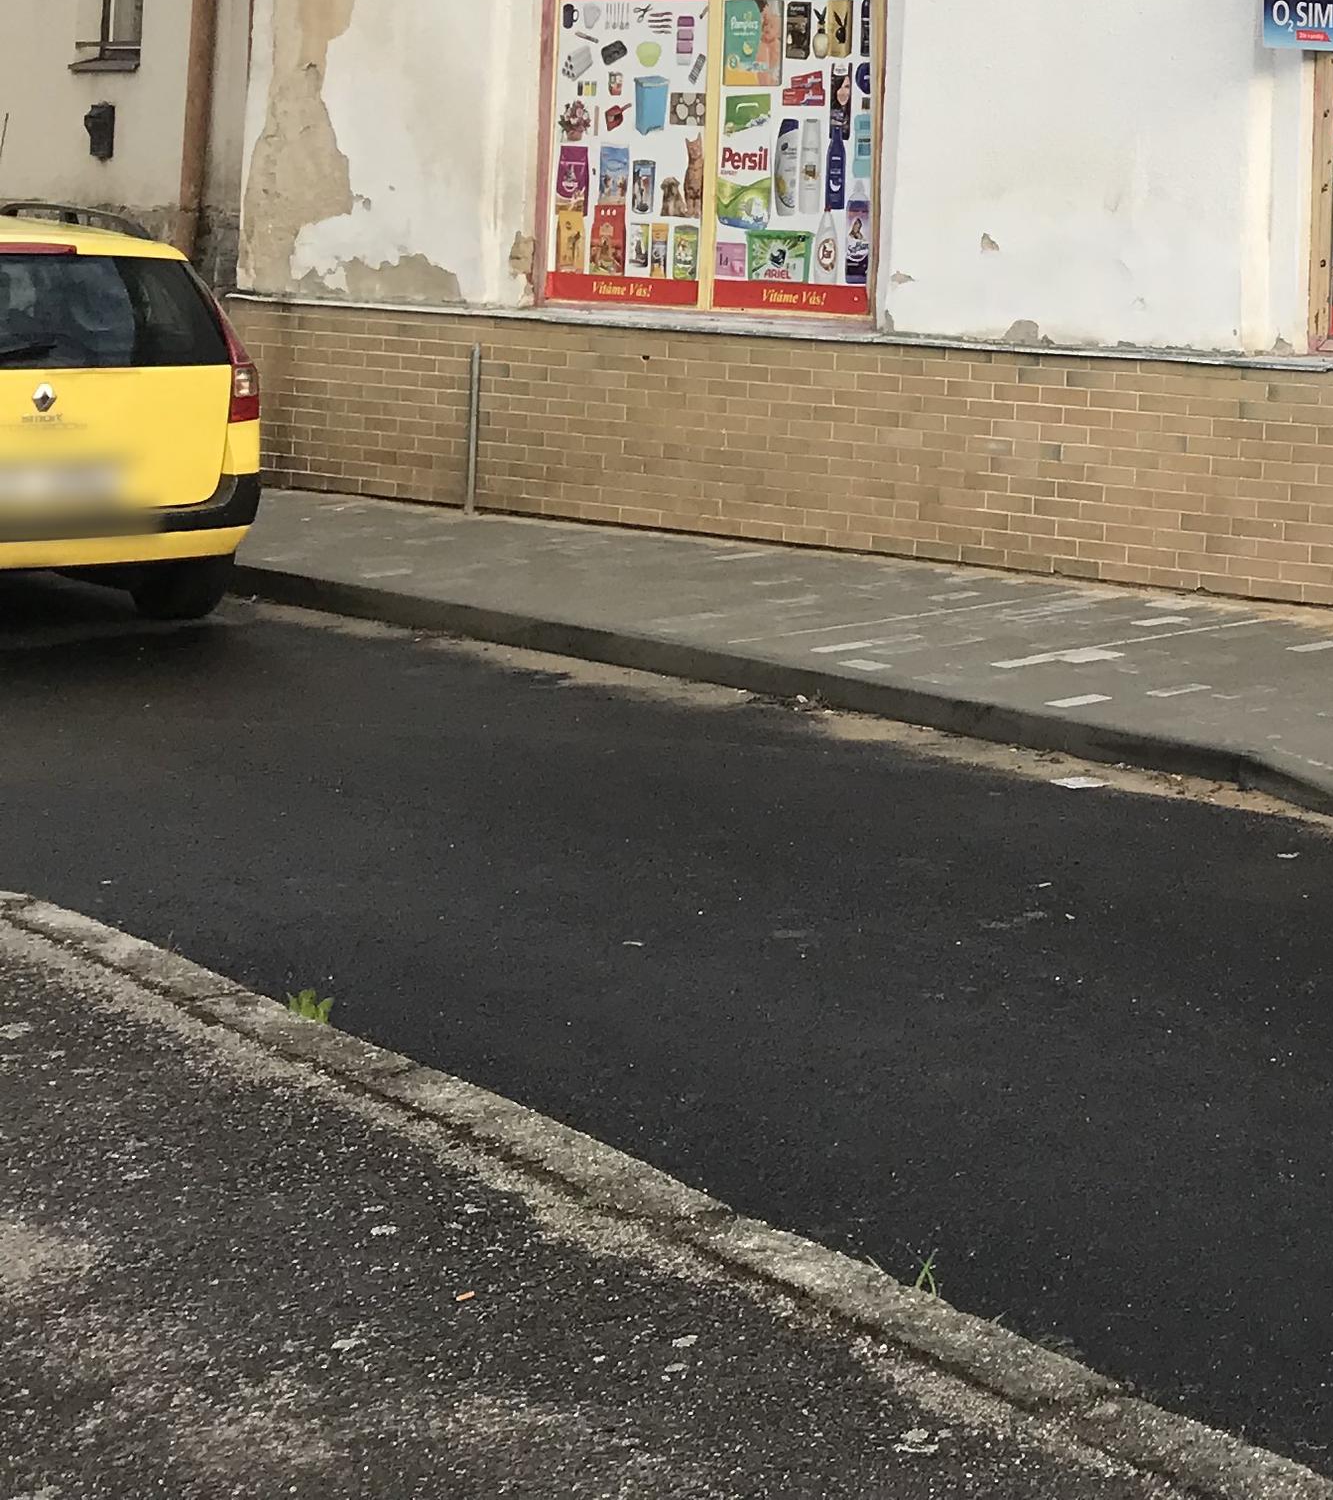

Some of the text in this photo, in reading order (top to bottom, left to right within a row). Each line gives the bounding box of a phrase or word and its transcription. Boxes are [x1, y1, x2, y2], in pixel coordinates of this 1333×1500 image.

[1296, 1, 1333, 28] SIM
[721, 146, 769, 171] Persil
[764, 268, 792, 280] ARIEL
[592, 281, 653, 298] Vítáme Vás!
[761, 288, 827, 306] Vítáme Vás!
